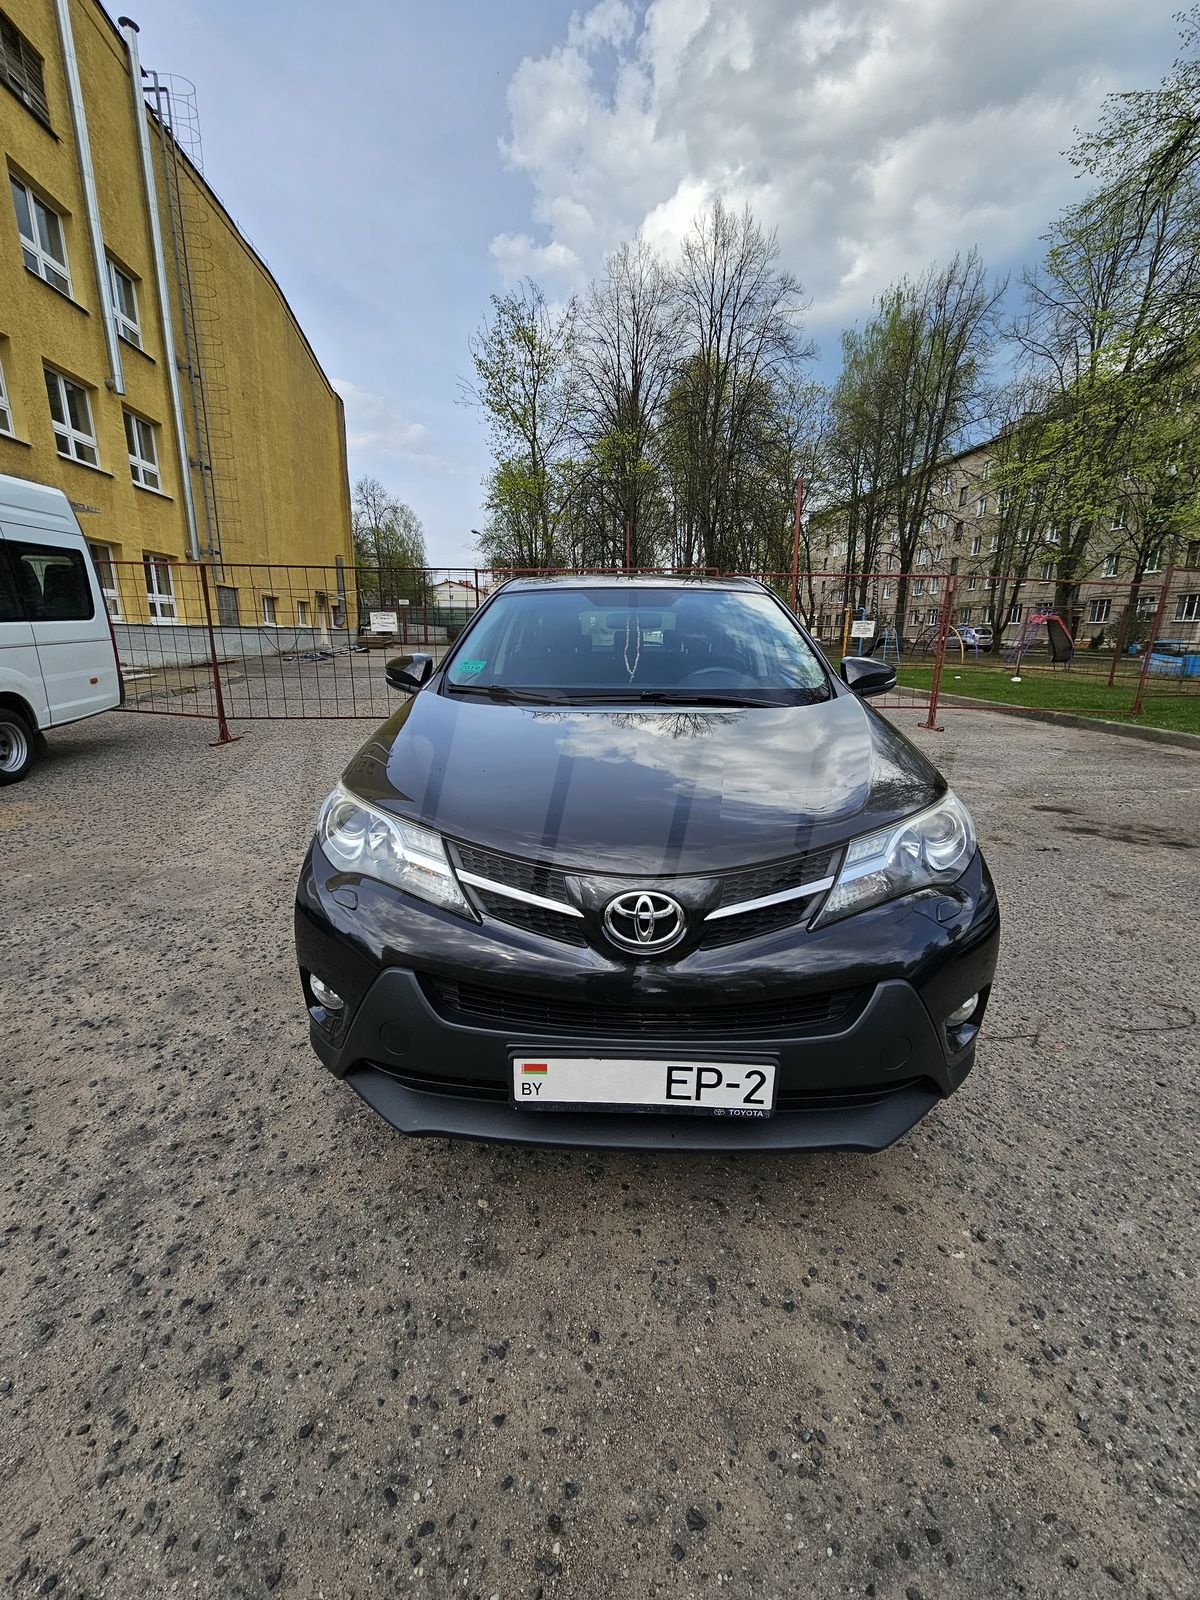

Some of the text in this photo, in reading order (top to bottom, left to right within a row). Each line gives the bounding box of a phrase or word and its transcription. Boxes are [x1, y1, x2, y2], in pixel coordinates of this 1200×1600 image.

[521, 1082, 543, 1096] BY
[666, 1066, 767, 1105] EP-2
[729, 1109, 764, 1117] TOYOTA
